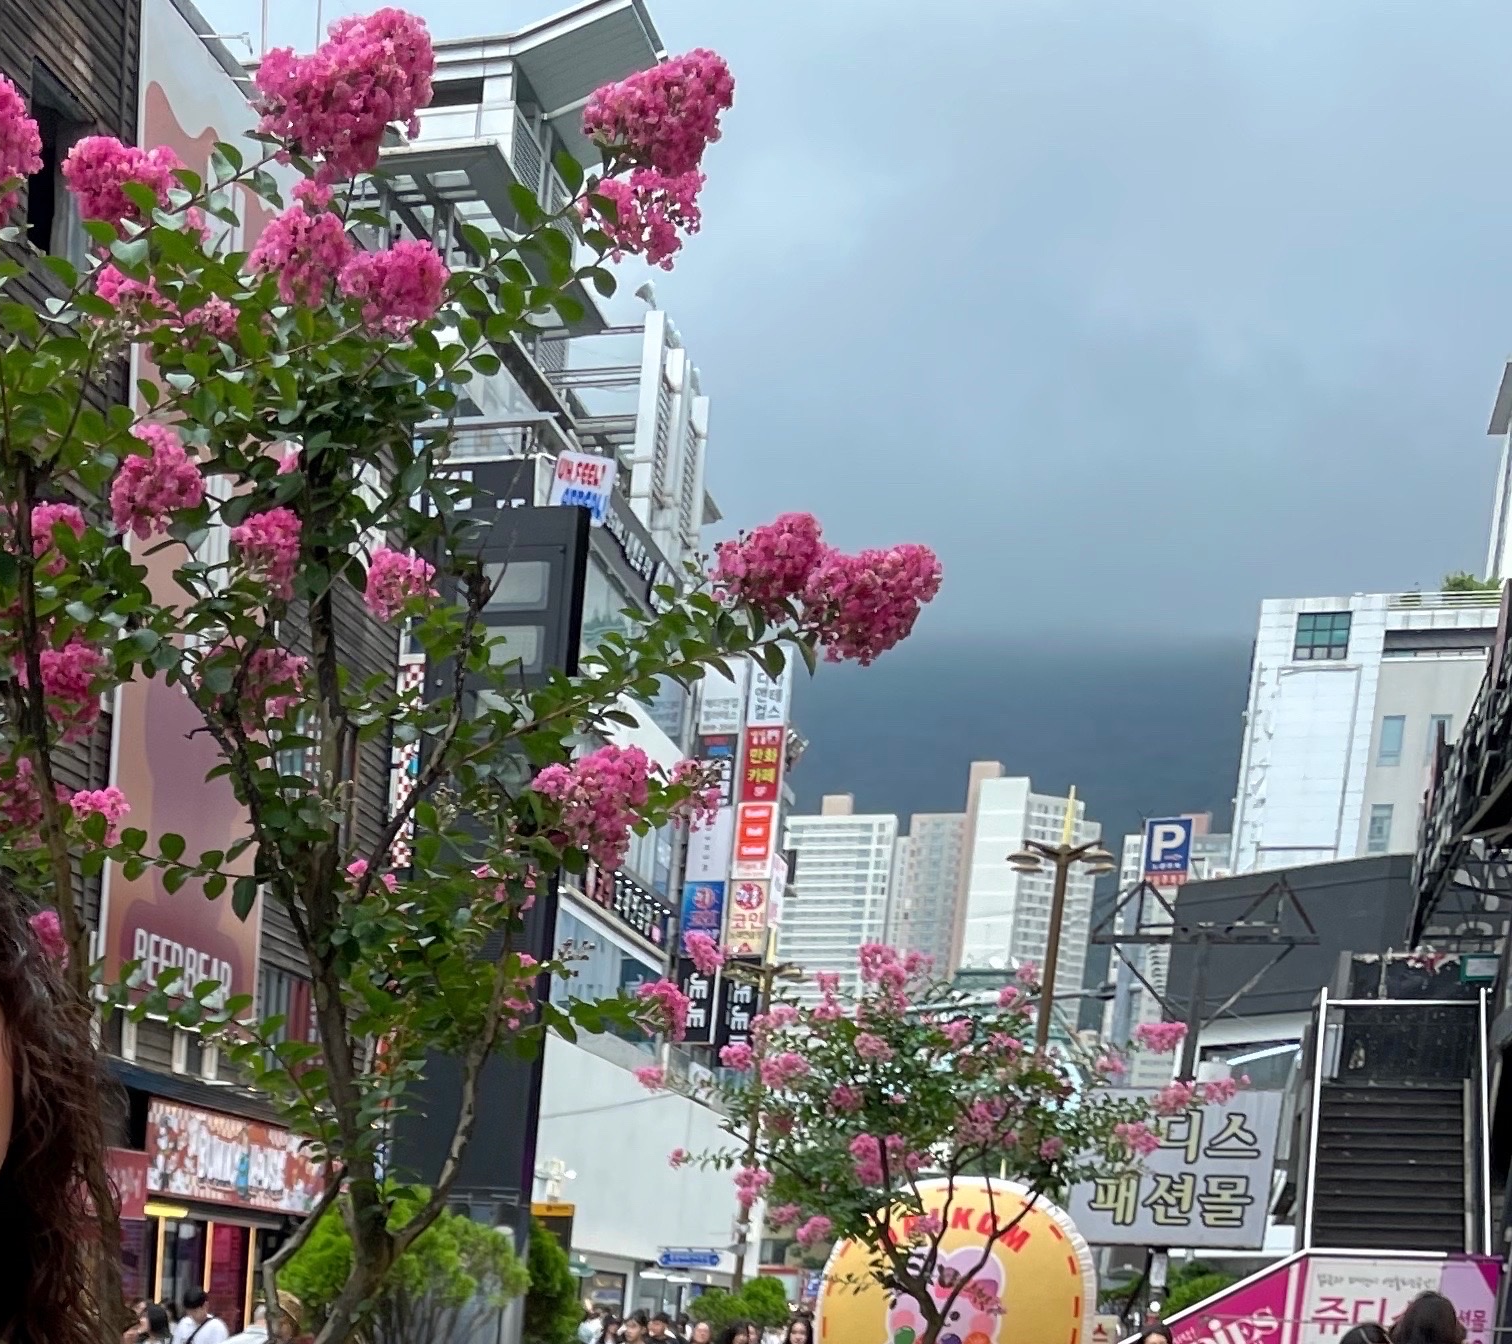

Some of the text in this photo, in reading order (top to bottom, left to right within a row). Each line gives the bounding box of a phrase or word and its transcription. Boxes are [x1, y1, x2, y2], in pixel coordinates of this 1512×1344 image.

[1151, 824, 1186, 862] P
[1088, 1172, 1256, 1229] 패션몰
[1311, 1295, 1417, 1335] 쥬디
